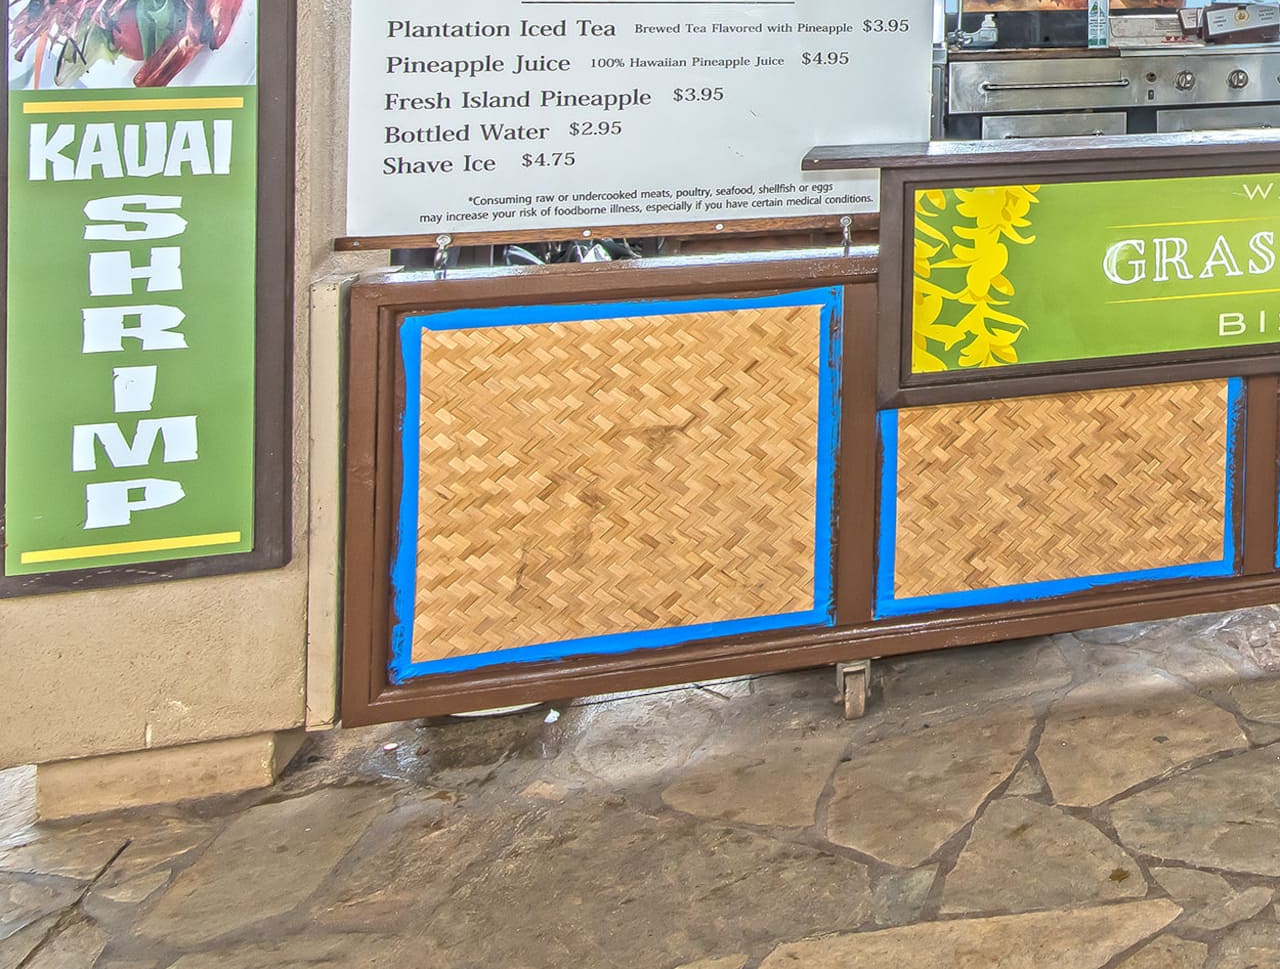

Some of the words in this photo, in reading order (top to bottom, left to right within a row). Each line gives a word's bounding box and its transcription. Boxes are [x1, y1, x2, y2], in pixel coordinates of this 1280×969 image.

[387, 20, 509, 37] Plantation
[519, 19, 565, 36] Iced
[575, 19, 615, 36] Tea
[634, 23, 680, 33] Brewed
[684, 23, 706, 33] Tea
[711, 23, 762, 32] Flavored
[767, 23, 792, 32] with
[797, 23, 852, 35] Pineapple
[862, 18, 908, 32] $3.95
[386, 54, 504, 77] Pineapple
[511, 54, 570, 74] Juice
[591, 58, 625, 67] 100%
[630, 57, 686, 67] Hawaiian
[691, 56, 750, 68] Pineapple
[753, 56, 784, 67] Juice
[801, 51, 848, 65] $4.95
[384, 91, 450, 110] Fresh
[461, 90, 529, 108] Island
[540, 88, 651, 110] Pineapple
[672, 87, 723, 102] $3.95
[384, 123, 469, 143] Bottled
[479, 123, 549, 140] Water
[569, 120, 621, 136] $2.95
[28, 119, 233, 181] KAUAI
[382, 156, 452, 174] Shave
[463, 154, 495, 171] Ice
[521, 151, 575, 167] $4.75
[535, 194, 554, 202] raw
[572, 189, 637, 201] undercooked
[640, 189, 672, 198] meats,
[675, 186, 712, 199] poultry,
[715, 184, 755, 195] seafood,
[758, 183, 795, 194] shellfish
[798, 184, 808, 192] or
[811, 183, 832, 193] eggs
[419, 214, 442, 224] may
[446, 211, 488, 221] increase
[491, 210, 516, 221] your
[519, 207, 537, 217] risk
[540, 206, 551, 216] of
[554, 205, 606, 215] foodborne
[609, 203, 642, 213] illness,
[645, 200, 692, 213] especially
[695, 199, 702, 209] if
[704, 202, 722, 211] you
[725, 199, 748, 208] have
[751, 198, 782, 207] certain
[786, 195, 821, 205] medical
[825, 194, 874, 205] conditions.
[72, 194, 199, 530] SHRIMP
